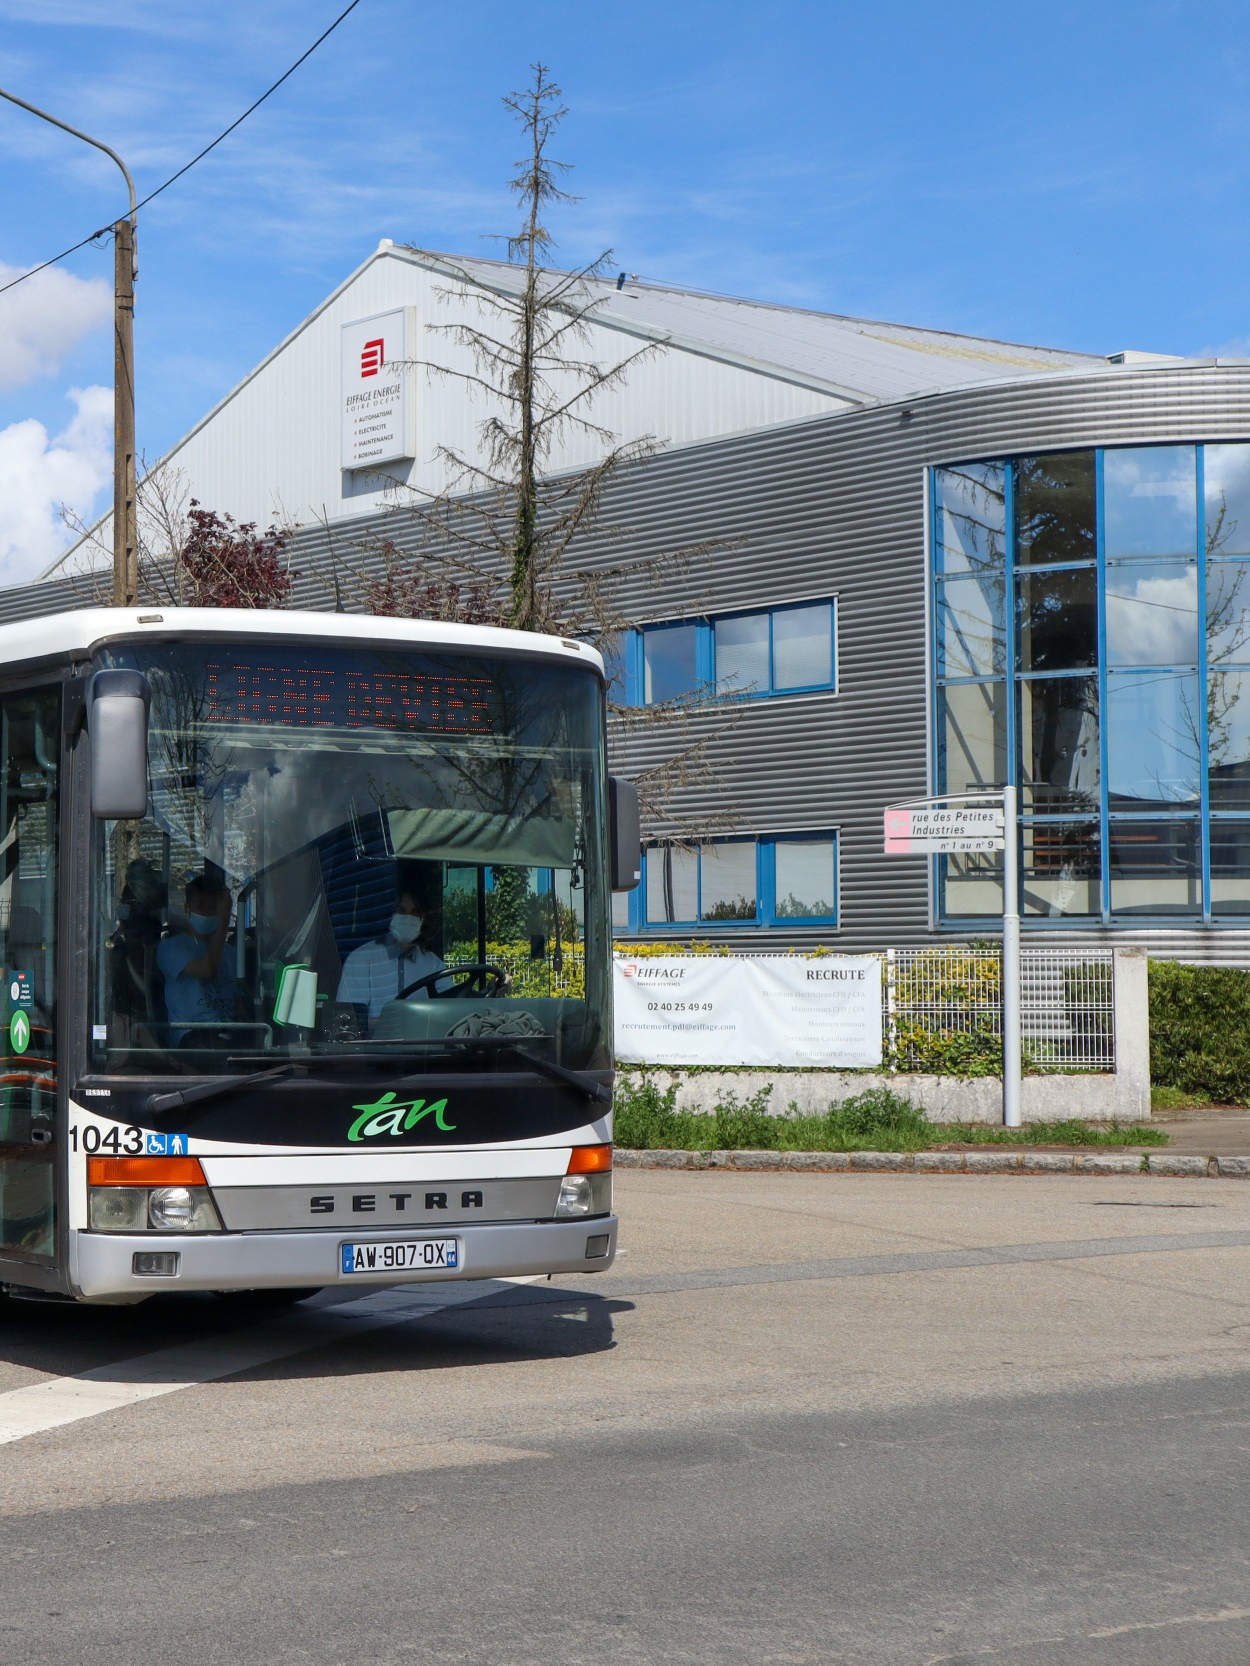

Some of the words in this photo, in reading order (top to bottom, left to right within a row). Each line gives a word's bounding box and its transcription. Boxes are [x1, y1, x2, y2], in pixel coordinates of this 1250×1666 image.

[346, 391, 372, 406] EIFFAGE
[358, 410, 392, 422] AUTOMATISME
[358, 434, 394, 446] MAINTENANCE
[912, 814, 929, 822] rue
[933, 812, 951, 822] des
[955, 812, 994, 822] Petites
[912, 825, 965, 835] Industries
[987, 841, 994, 849] 9
[637, 968, 686, 978] EIFFAGE
[806, 970, 866, 980] RECRUTE
[647, 1002, 658, 1011] 02
[661, 1002, 672, 1011] 40
[674, 1002, 686, 1011] 25
[688, 1002, 700, 1011] 49
[702, 1002, 713, 1011] 49
[621, 1023, 736, 1032] recrutement.pdl@eiffage.com
[348, 1092, 456, 1141] tan
[69, 1125, 144, 1154] 1043
[310, 1190, 483, 1214] SETRA
[355, 1243, 445, 1269] AW-907-QX
